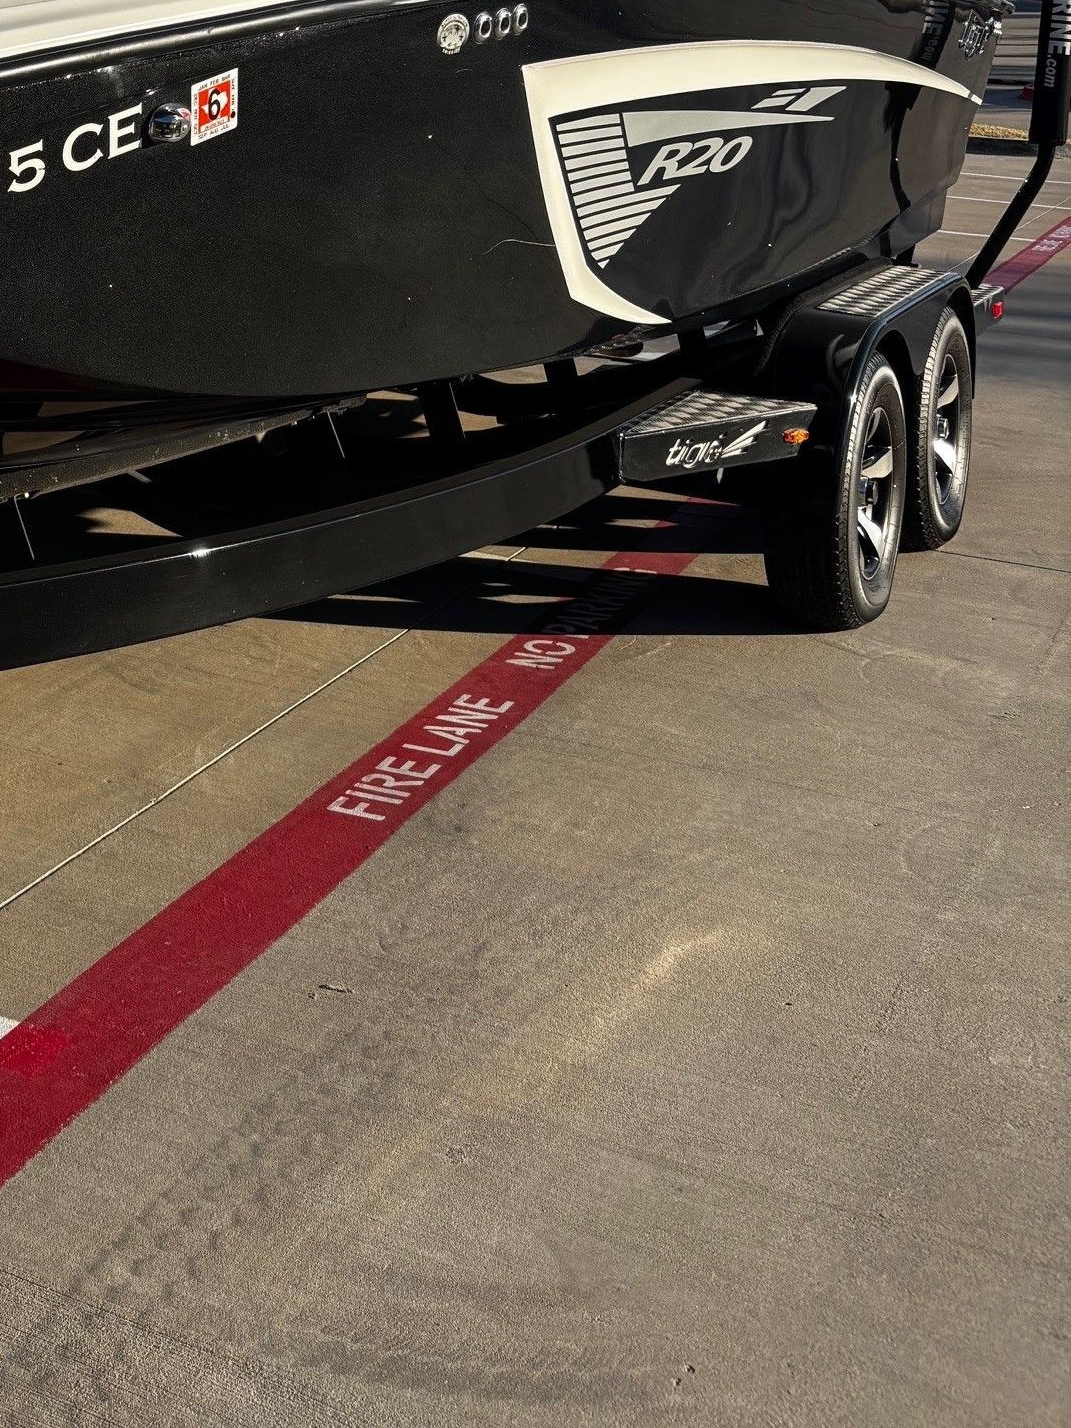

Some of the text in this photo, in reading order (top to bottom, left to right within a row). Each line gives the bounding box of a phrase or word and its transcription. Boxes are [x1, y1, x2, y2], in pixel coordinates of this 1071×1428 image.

[208, 88, 221, 121] 6
[62, 103, 143, 172] CE
[636, 135, 753, 186] R20
[326, 755, 442, 822] FIRE
[401, 693, 515, 757] LANE
[504, 638, 576, 670] NO
